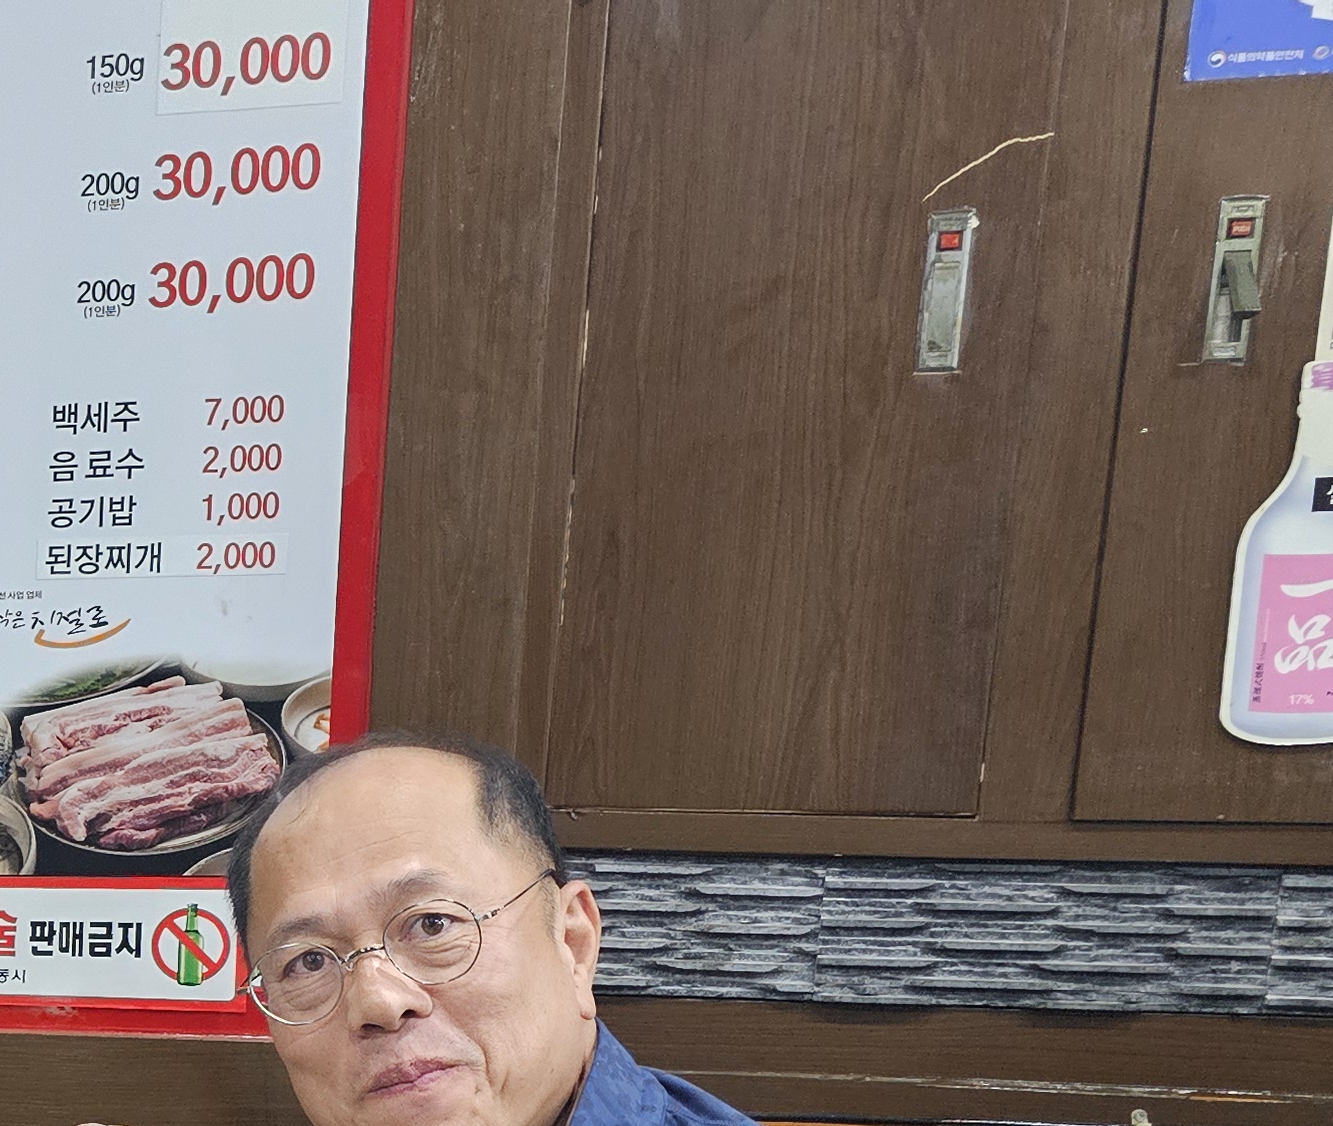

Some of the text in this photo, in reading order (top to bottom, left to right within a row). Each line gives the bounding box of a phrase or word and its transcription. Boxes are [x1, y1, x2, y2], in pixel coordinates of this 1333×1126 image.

[86, 54, 145, 83] 150g
[160, 31, 332, 97] 30,000
[91, 79, 131, 96] (1인분)
[80, 171, 140, 200] 200g
[152, 142, 322, 206] 30,000
[86, 198, 126, 213] (1인분)
[76, 280, 136, 309] 200g
[147, 252, 315, 315] 30,000
[82, 304, 122, 320] (1인분)
[52, 394, 286, 435] 백세주 7,000
[201, 443, 283, 478] 2,000
[47, 491, 281, 530] 공기밥 1,000
[44, 541, 277, 576] 된장찌개 2,000
[1289, 693, 1315, 706] 17%
[28, 921, 144, 960] 판매금지
